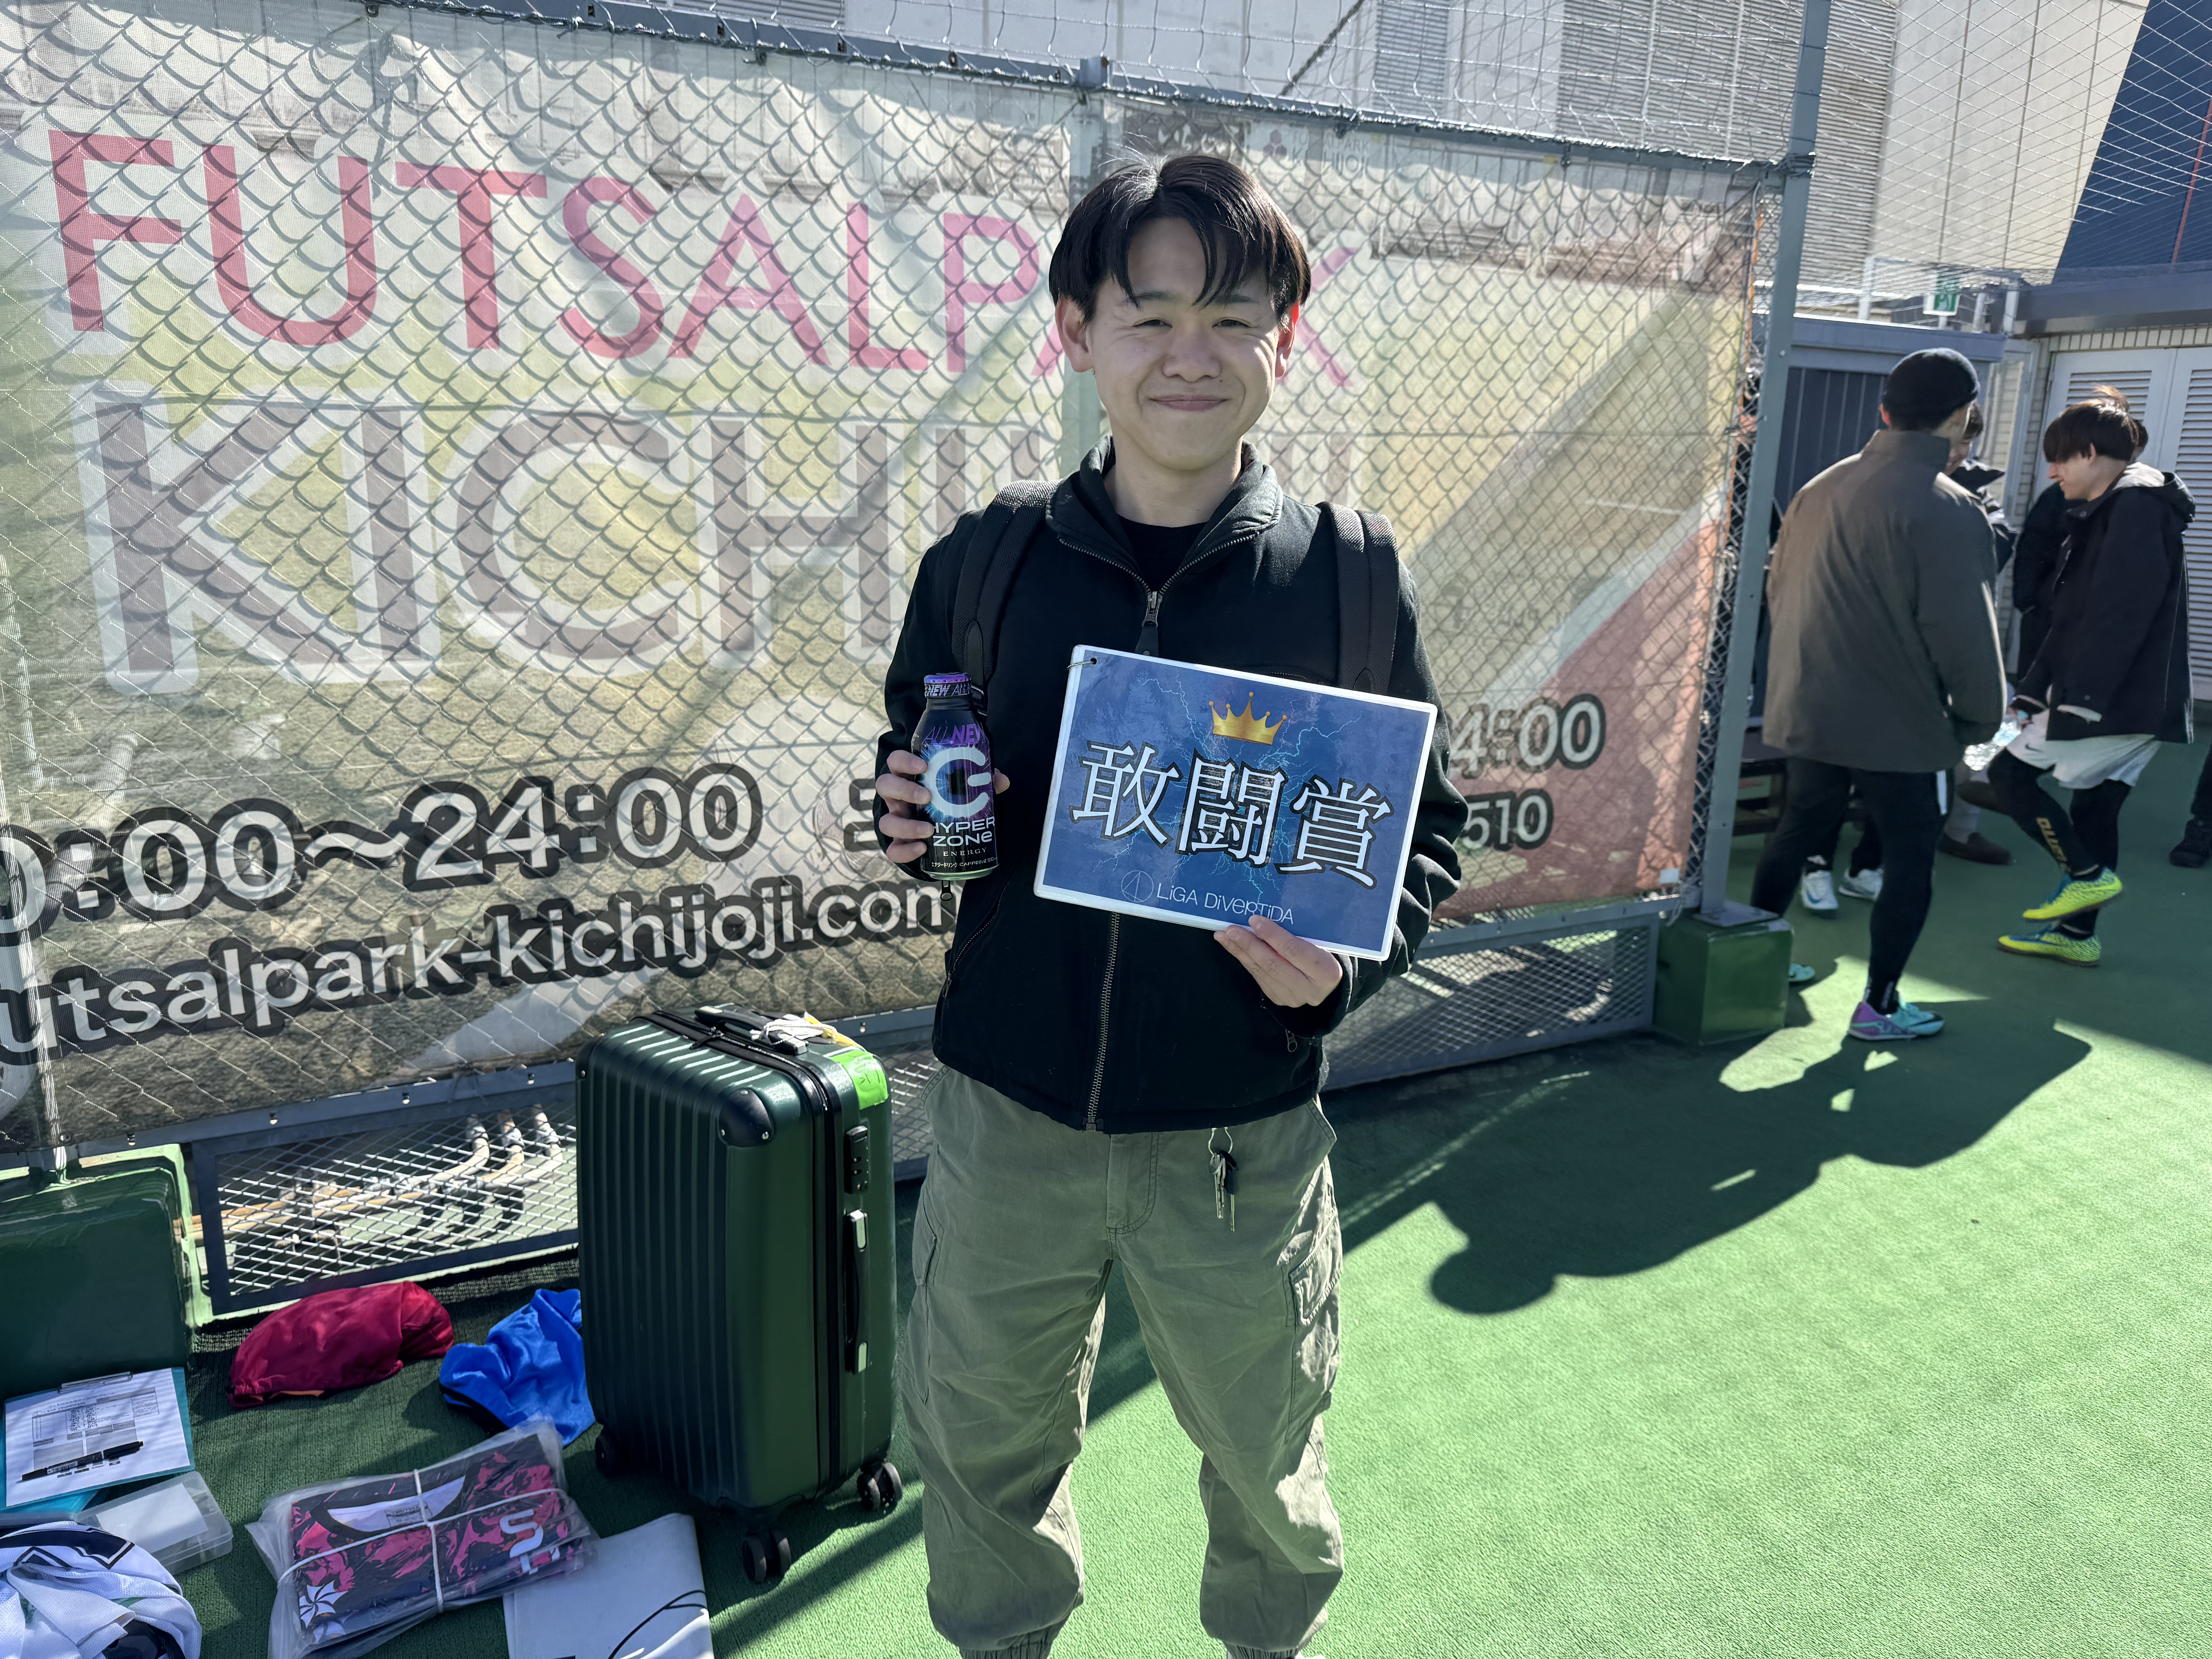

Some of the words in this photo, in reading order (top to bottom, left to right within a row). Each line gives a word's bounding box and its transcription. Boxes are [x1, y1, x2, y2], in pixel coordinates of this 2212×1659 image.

[48, 129, 1361, 387] FUTSALPK
[1449, 700, 1601, 772] 4:00
[943, 847, 986, 857] ENERGY
[1070, 742, 1392, 888] 敢闘賞
